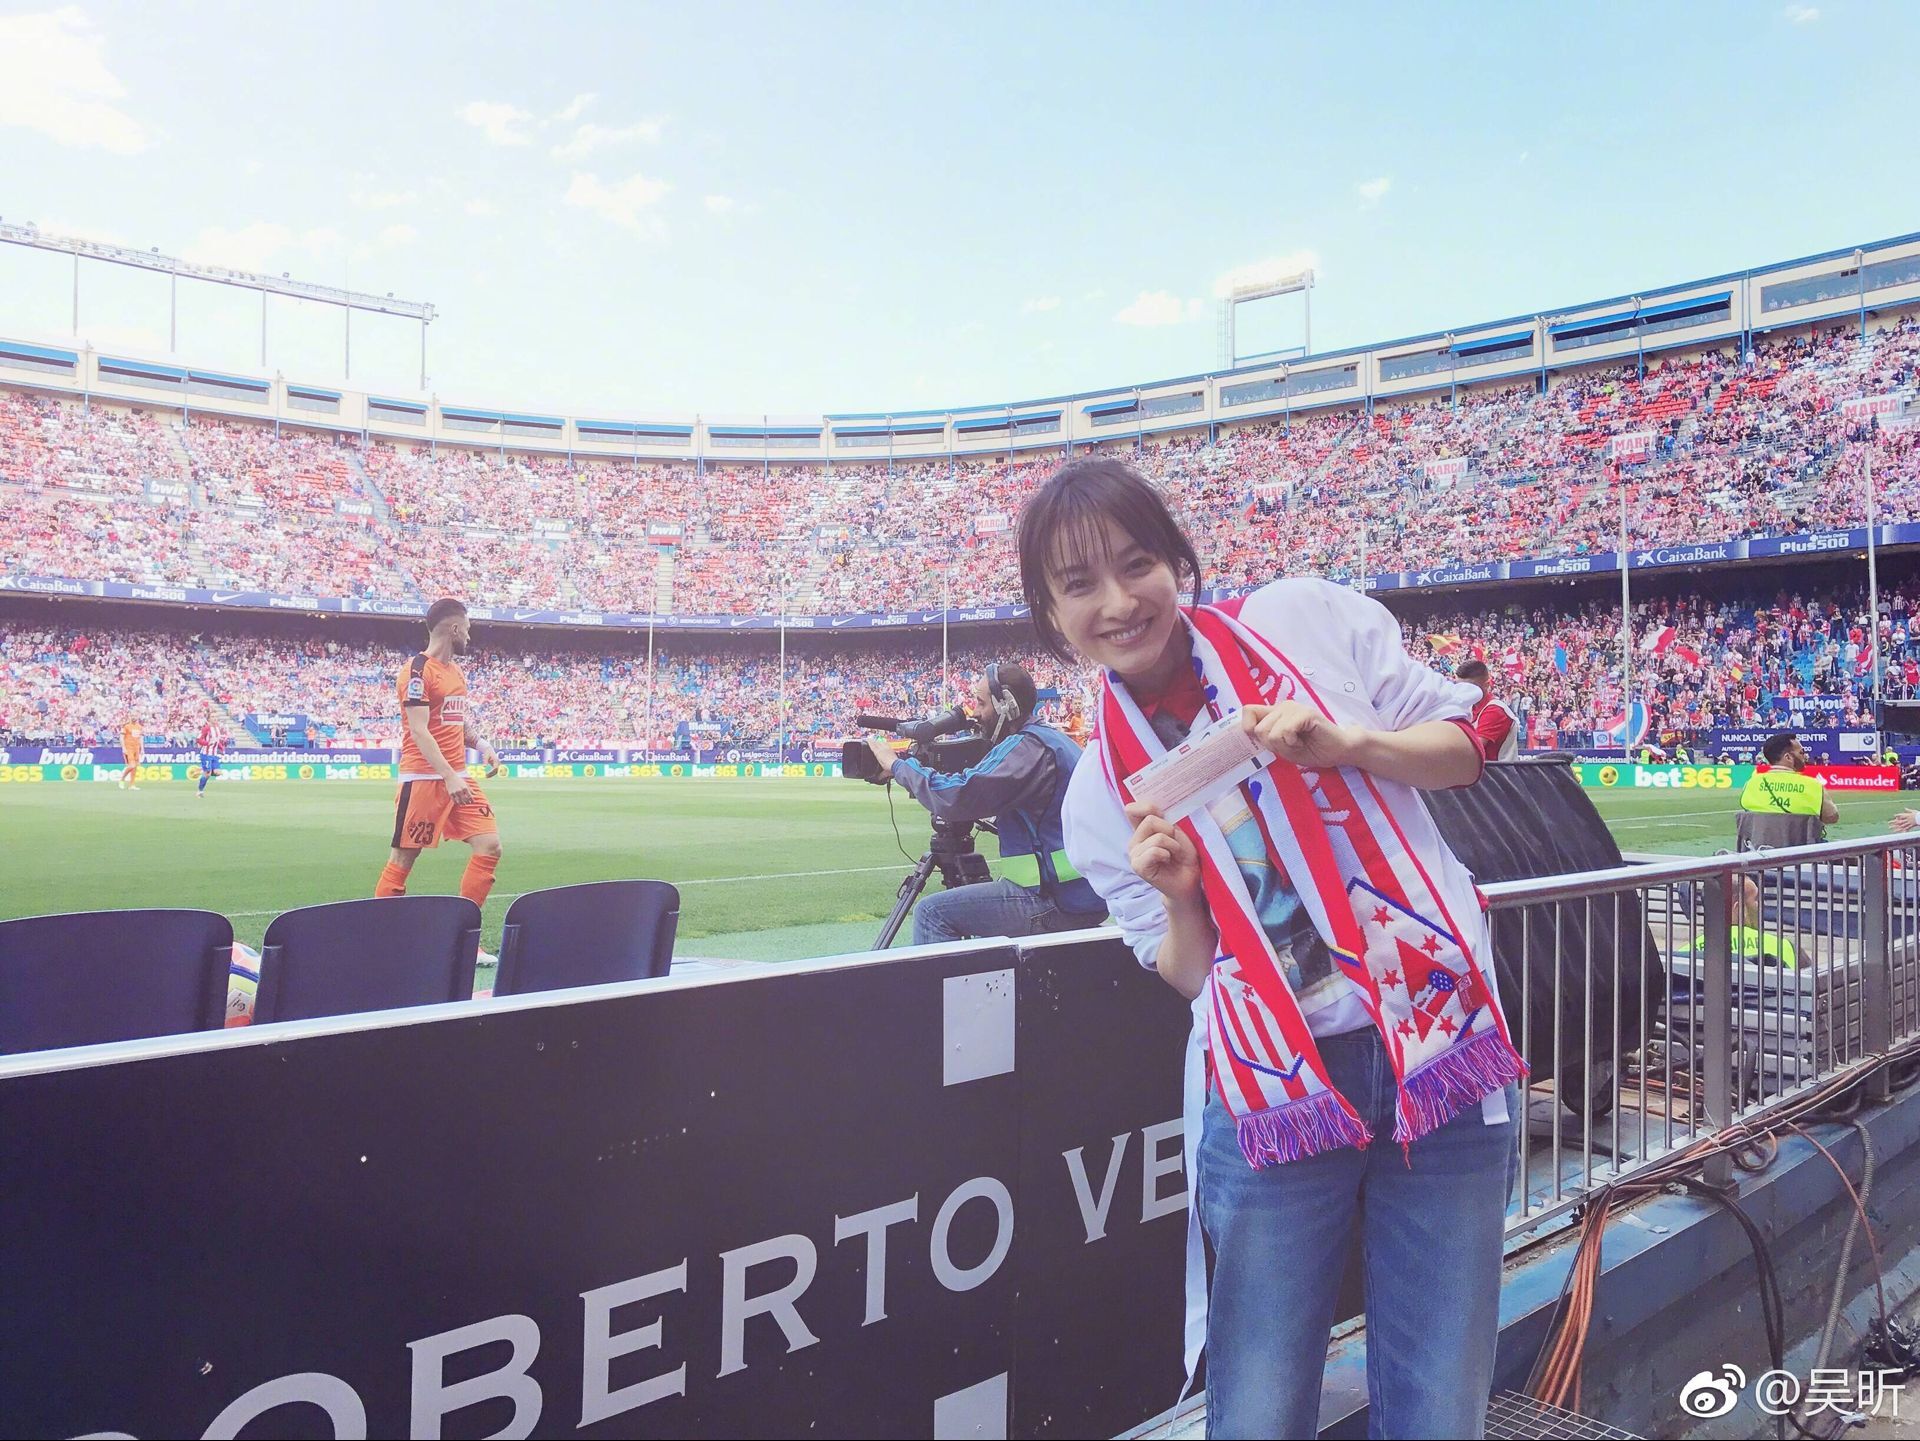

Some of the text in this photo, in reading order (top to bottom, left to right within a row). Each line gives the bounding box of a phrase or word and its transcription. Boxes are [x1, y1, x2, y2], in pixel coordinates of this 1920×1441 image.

[1845, 400, 1897, 417] MARCA
[1425, 463, 1466, 476] MARCA
[1781, 538, 1849, 553] Plus500
[1656, 545, 1727, 563] CaixaBank
[1535, 562, 1590, 574] Plus500
[1433, 567, 1491, 583] CaixaBank
[17, 577, 84, 593] CaixaBank
[131, 587, 186, 601] Plus500
[373, 602, 425, 615] CaixaBank
[960, 611, 995, 620] Plus500
[872, 617, 907, 629] Plus500
[1722, 734, 1750, 742] NUNCA
[1796, 733, 1827, 742] SENTIR
[39, 748, 94, 765] bwin
[497, 751, 540, 762] CaixaBank
[570, 751, 614, 762] CaixaBank
[0, 765, 43, 782] 365
[325, 765, 391, 780] bet365
[517, 765, 573, 777] bet365
[604, 765, 659, 777] bet365
[692, 764, 737, 777] bet365
[761, 764, 807, 777] bet365
[1634, 765, 1732, 789] bet365
[1829, 774, 1896, 787] Santander
[1759, 782, 1805, 793] SEGURIDAD
[415, 821, 435, 845] 23
[62, 1117, 1188, 1440] BERTO VE
